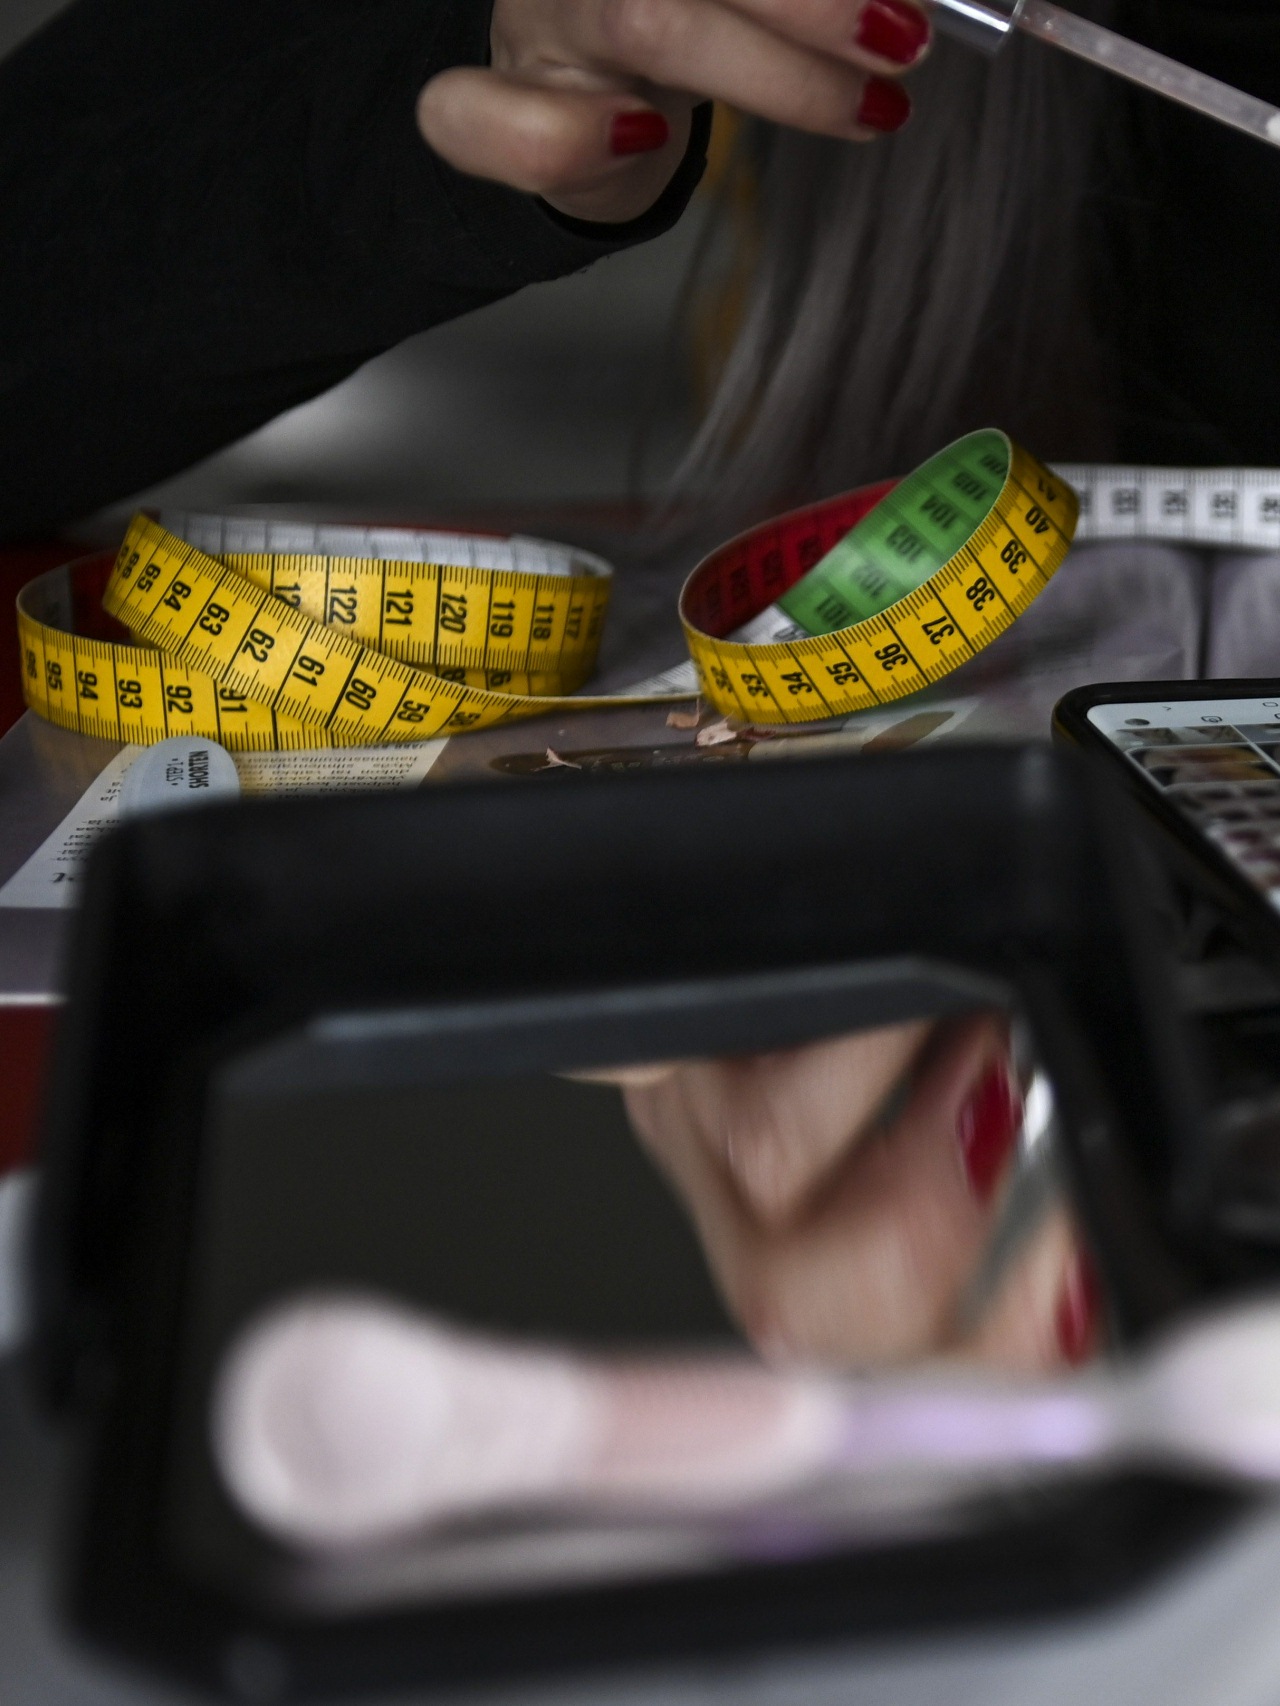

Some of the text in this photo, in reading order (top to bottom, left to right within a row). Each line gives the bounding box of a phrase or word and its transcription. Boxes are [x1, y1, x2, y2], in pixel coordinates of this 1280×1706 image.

[327, 585, 357, 625] 122
[385, 588, 414, 627] 121
[440, 593, 468, 635] 120
[490, 599, 516, 638] 119
[532, 603, 555, 641] 118
[565, 604, 584, 640] 117
[741, 672, 769, 698] 33
[781, 671, 812, 696] 34
[826, 661, 859, 686] 35
[874, 642, 908, 671] 36
[922, 616, 955, 645] 37
[966, 577, 995, 612] 38
[1000, 539, 1027, 574] 39
[1025, 505, 1050, 534] 40
[137, 563, 161, 593] 65
[164, 580, 192, 612] 64
[199, 602, 230, 636] 63
[241, 628, 275, 663] 62
[292, 654, 325, 687] 61
[345, 677, 377, 711] 60
[397, 699, 431, 724] 59
[47, 660, 63, 691] 95
[77, 671, 99, 701] 94
[118, 679, 143, 709] 93
[166, 684, 193, 714] 92
[220, 687, 248, 713] 91
[188, 750, 210, 789] SHORTEN
